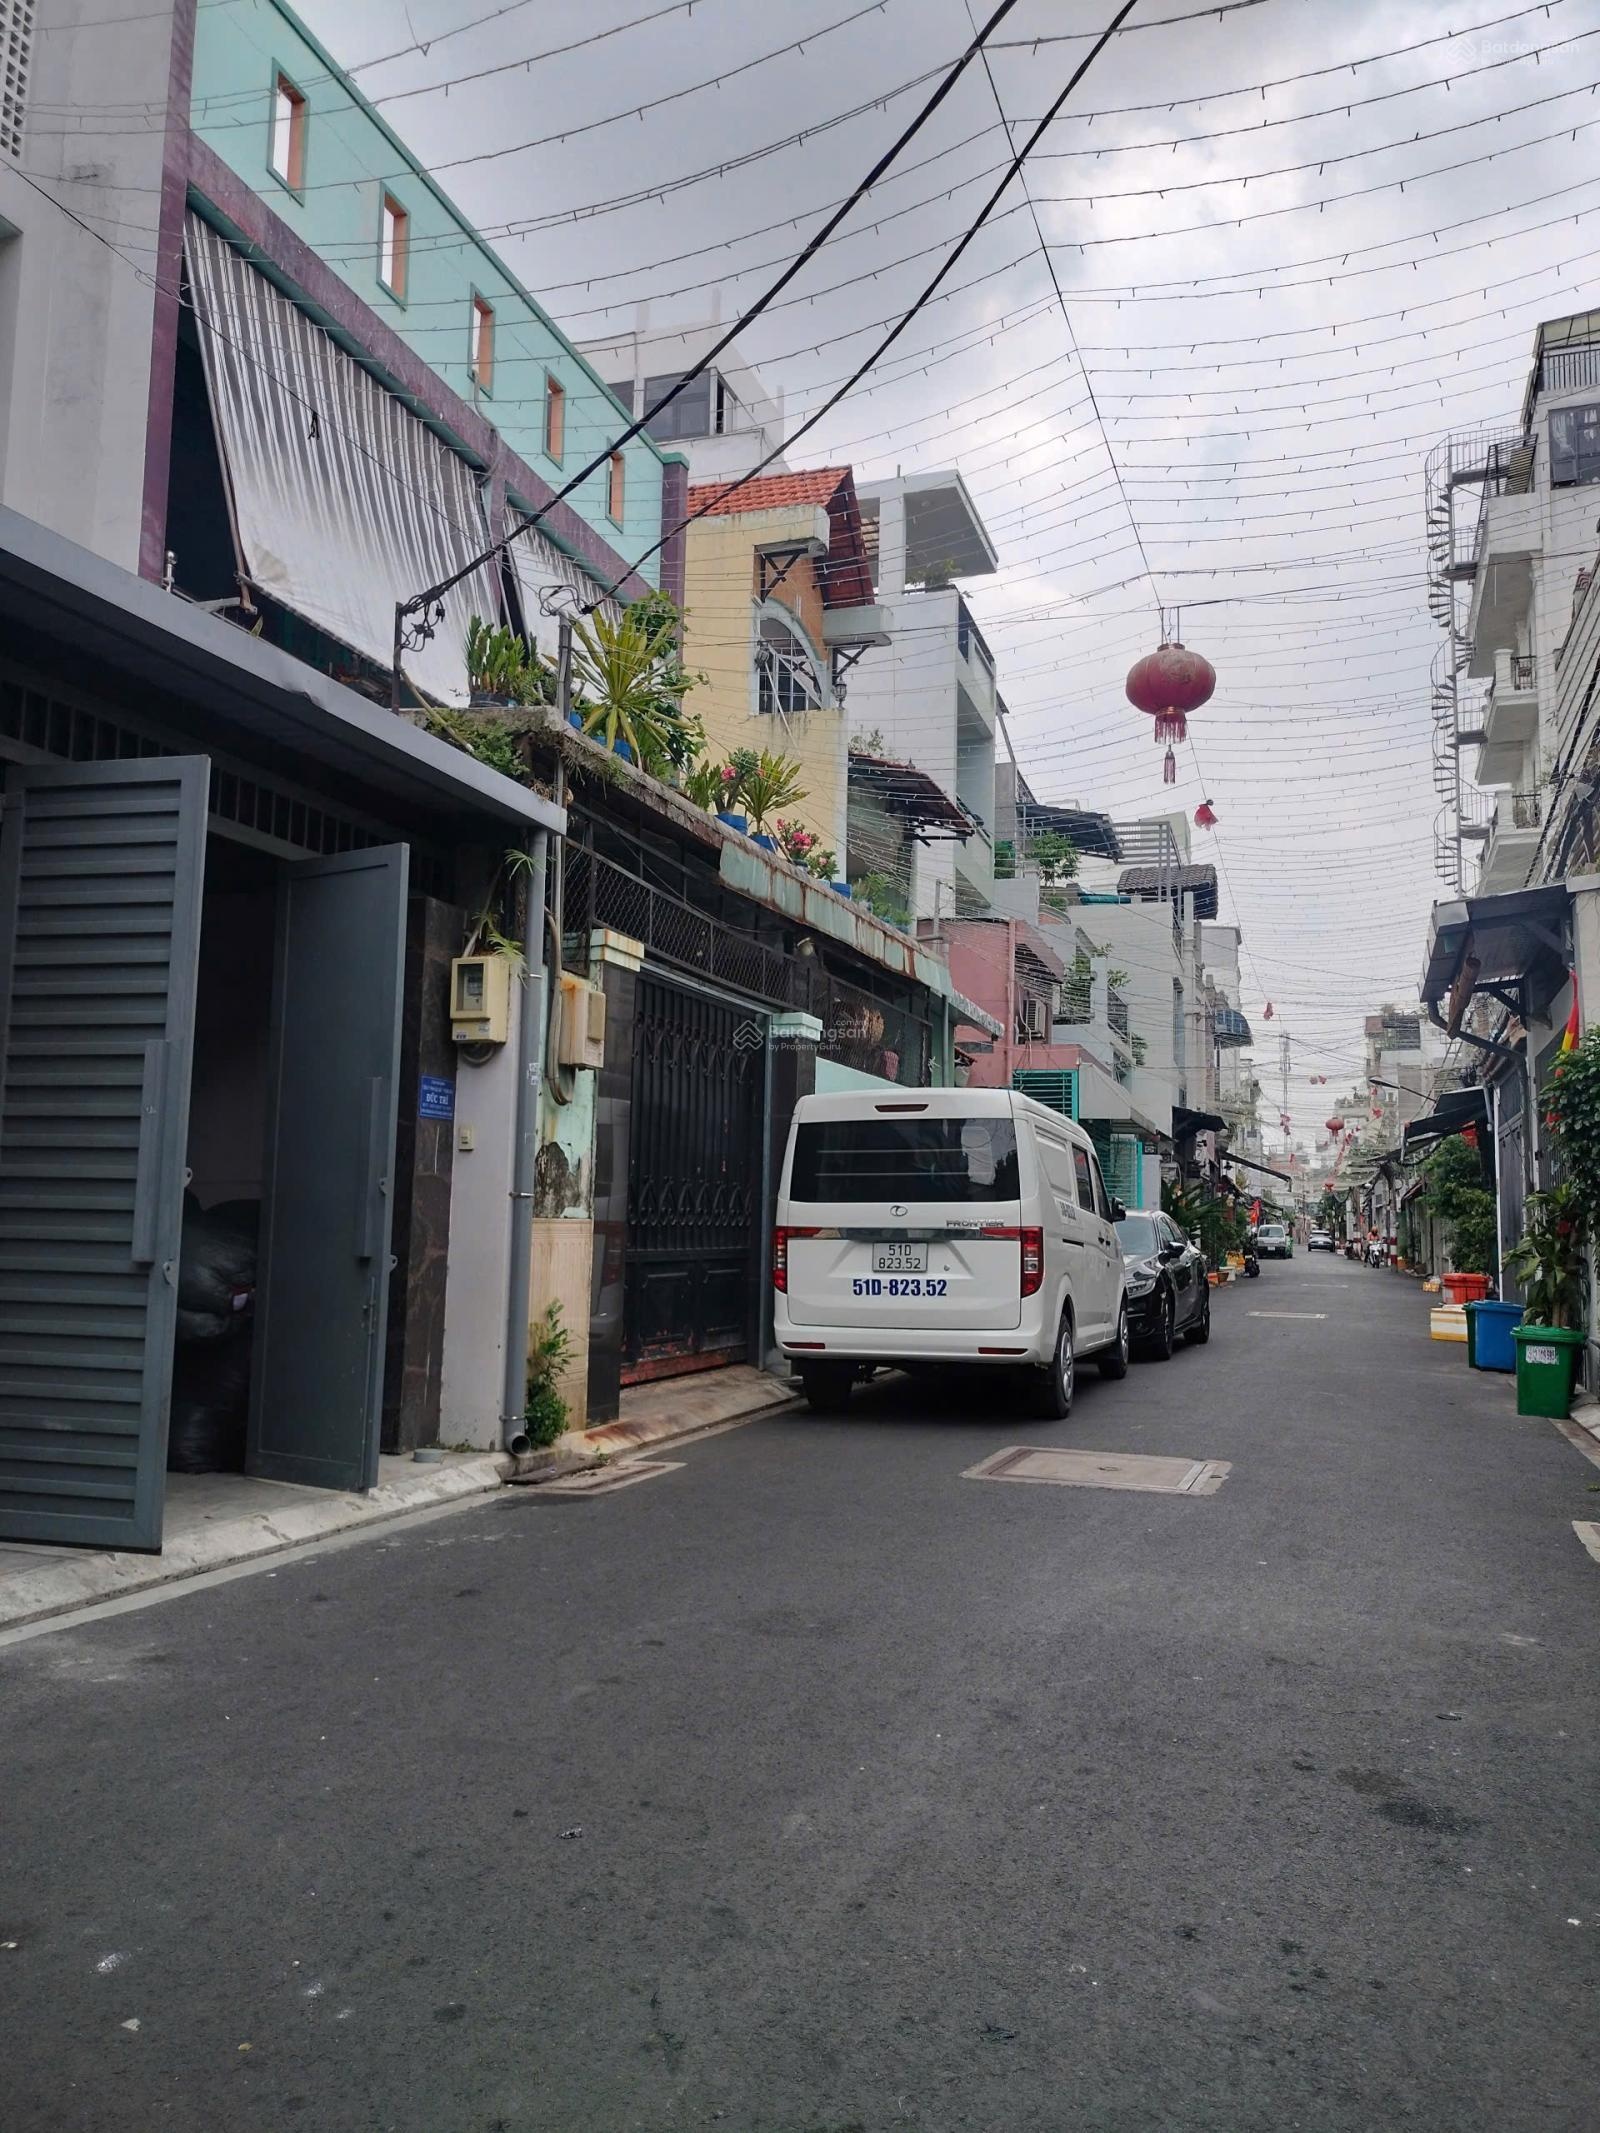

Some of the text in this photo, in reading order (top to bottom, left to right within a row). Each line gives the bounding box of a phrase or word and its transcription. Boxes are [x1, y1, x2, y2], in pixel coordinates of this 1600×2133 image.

[946, 1219, 1005, 1228] FRONTIER
[888, 1244, 912, 1256] 51D
[878, 1257, 921, 1270] 823.52
[853, 1278, 948, 1297] 51D-823.52
